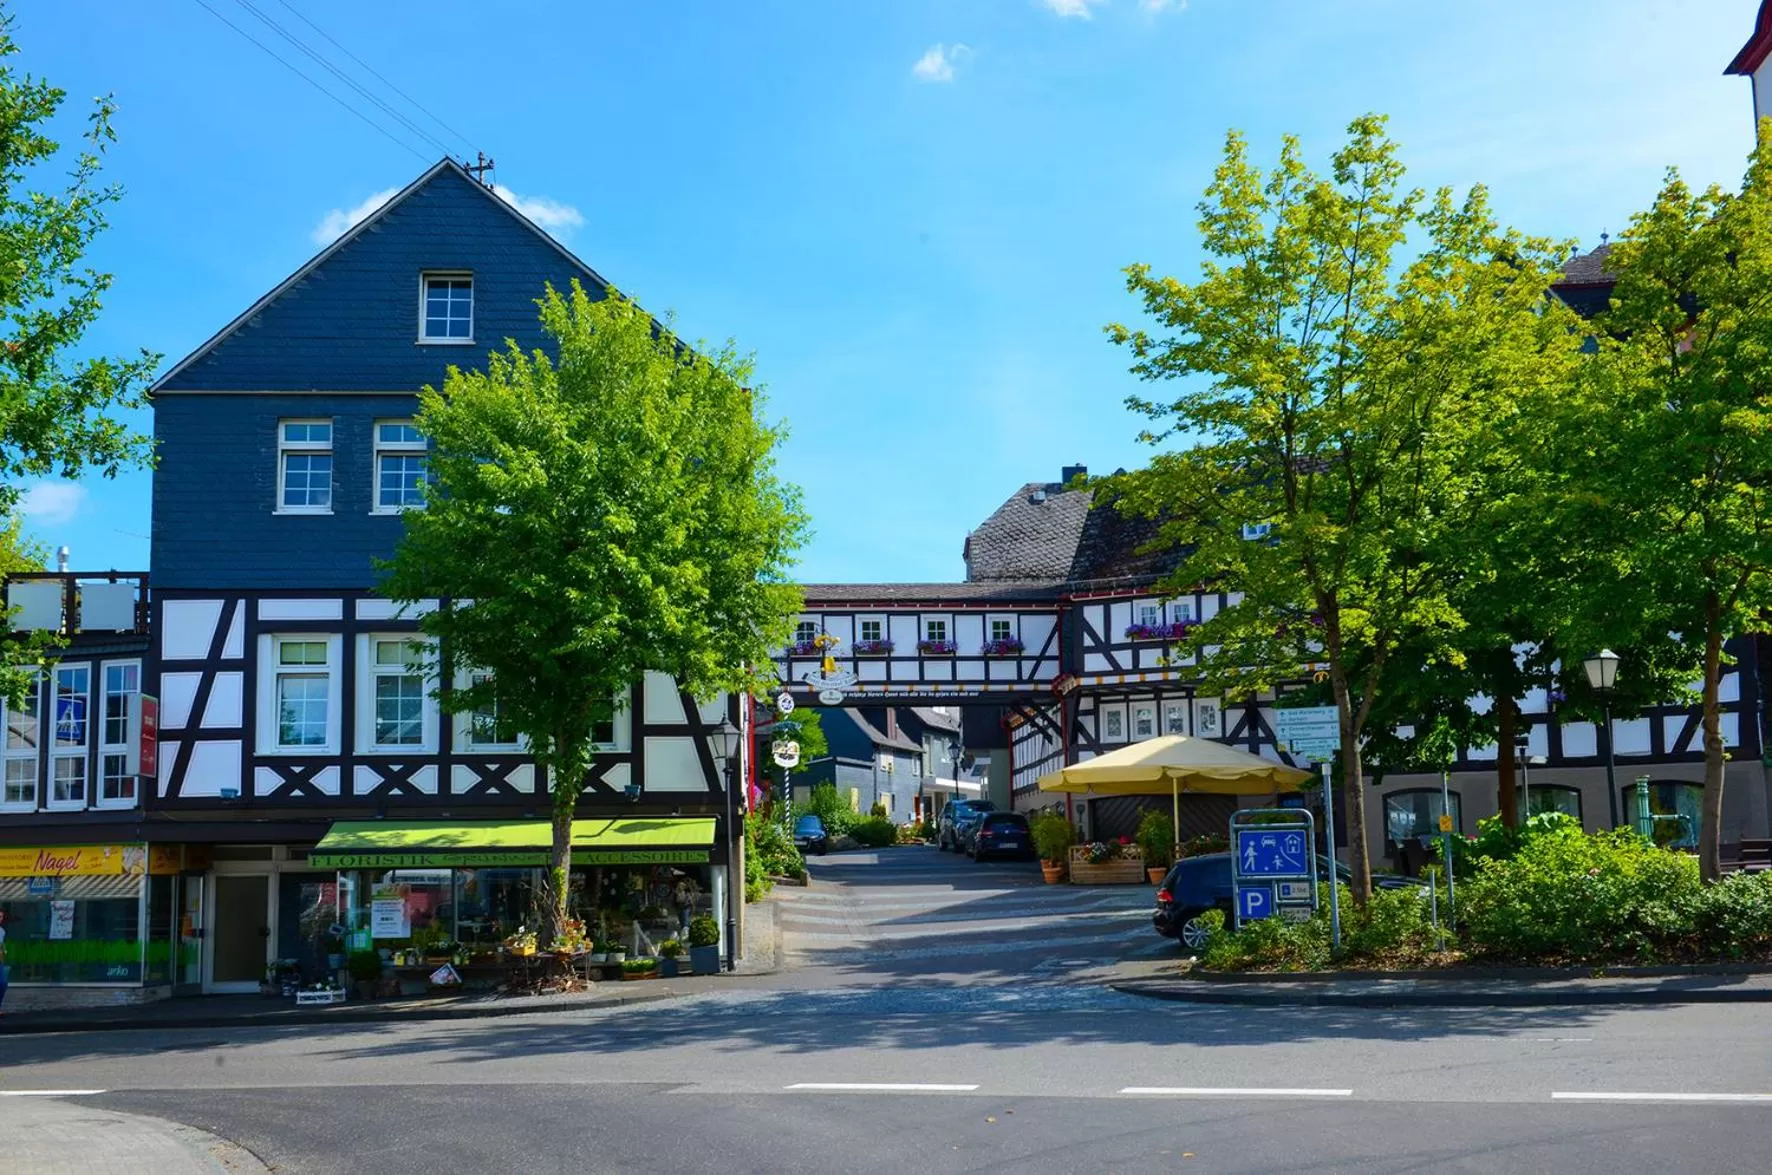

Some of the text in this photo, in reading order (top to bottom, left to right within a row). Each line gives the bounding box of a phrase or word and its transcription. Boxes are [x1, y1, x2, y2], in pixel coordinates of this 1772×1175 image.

[33, 848, 82, 876] Nagel
[311, 854, 434, 867] FLORISTIK
[584, 850, 707, 864] ACCESSOIRES
[1246, 892, 1264, 915] P
